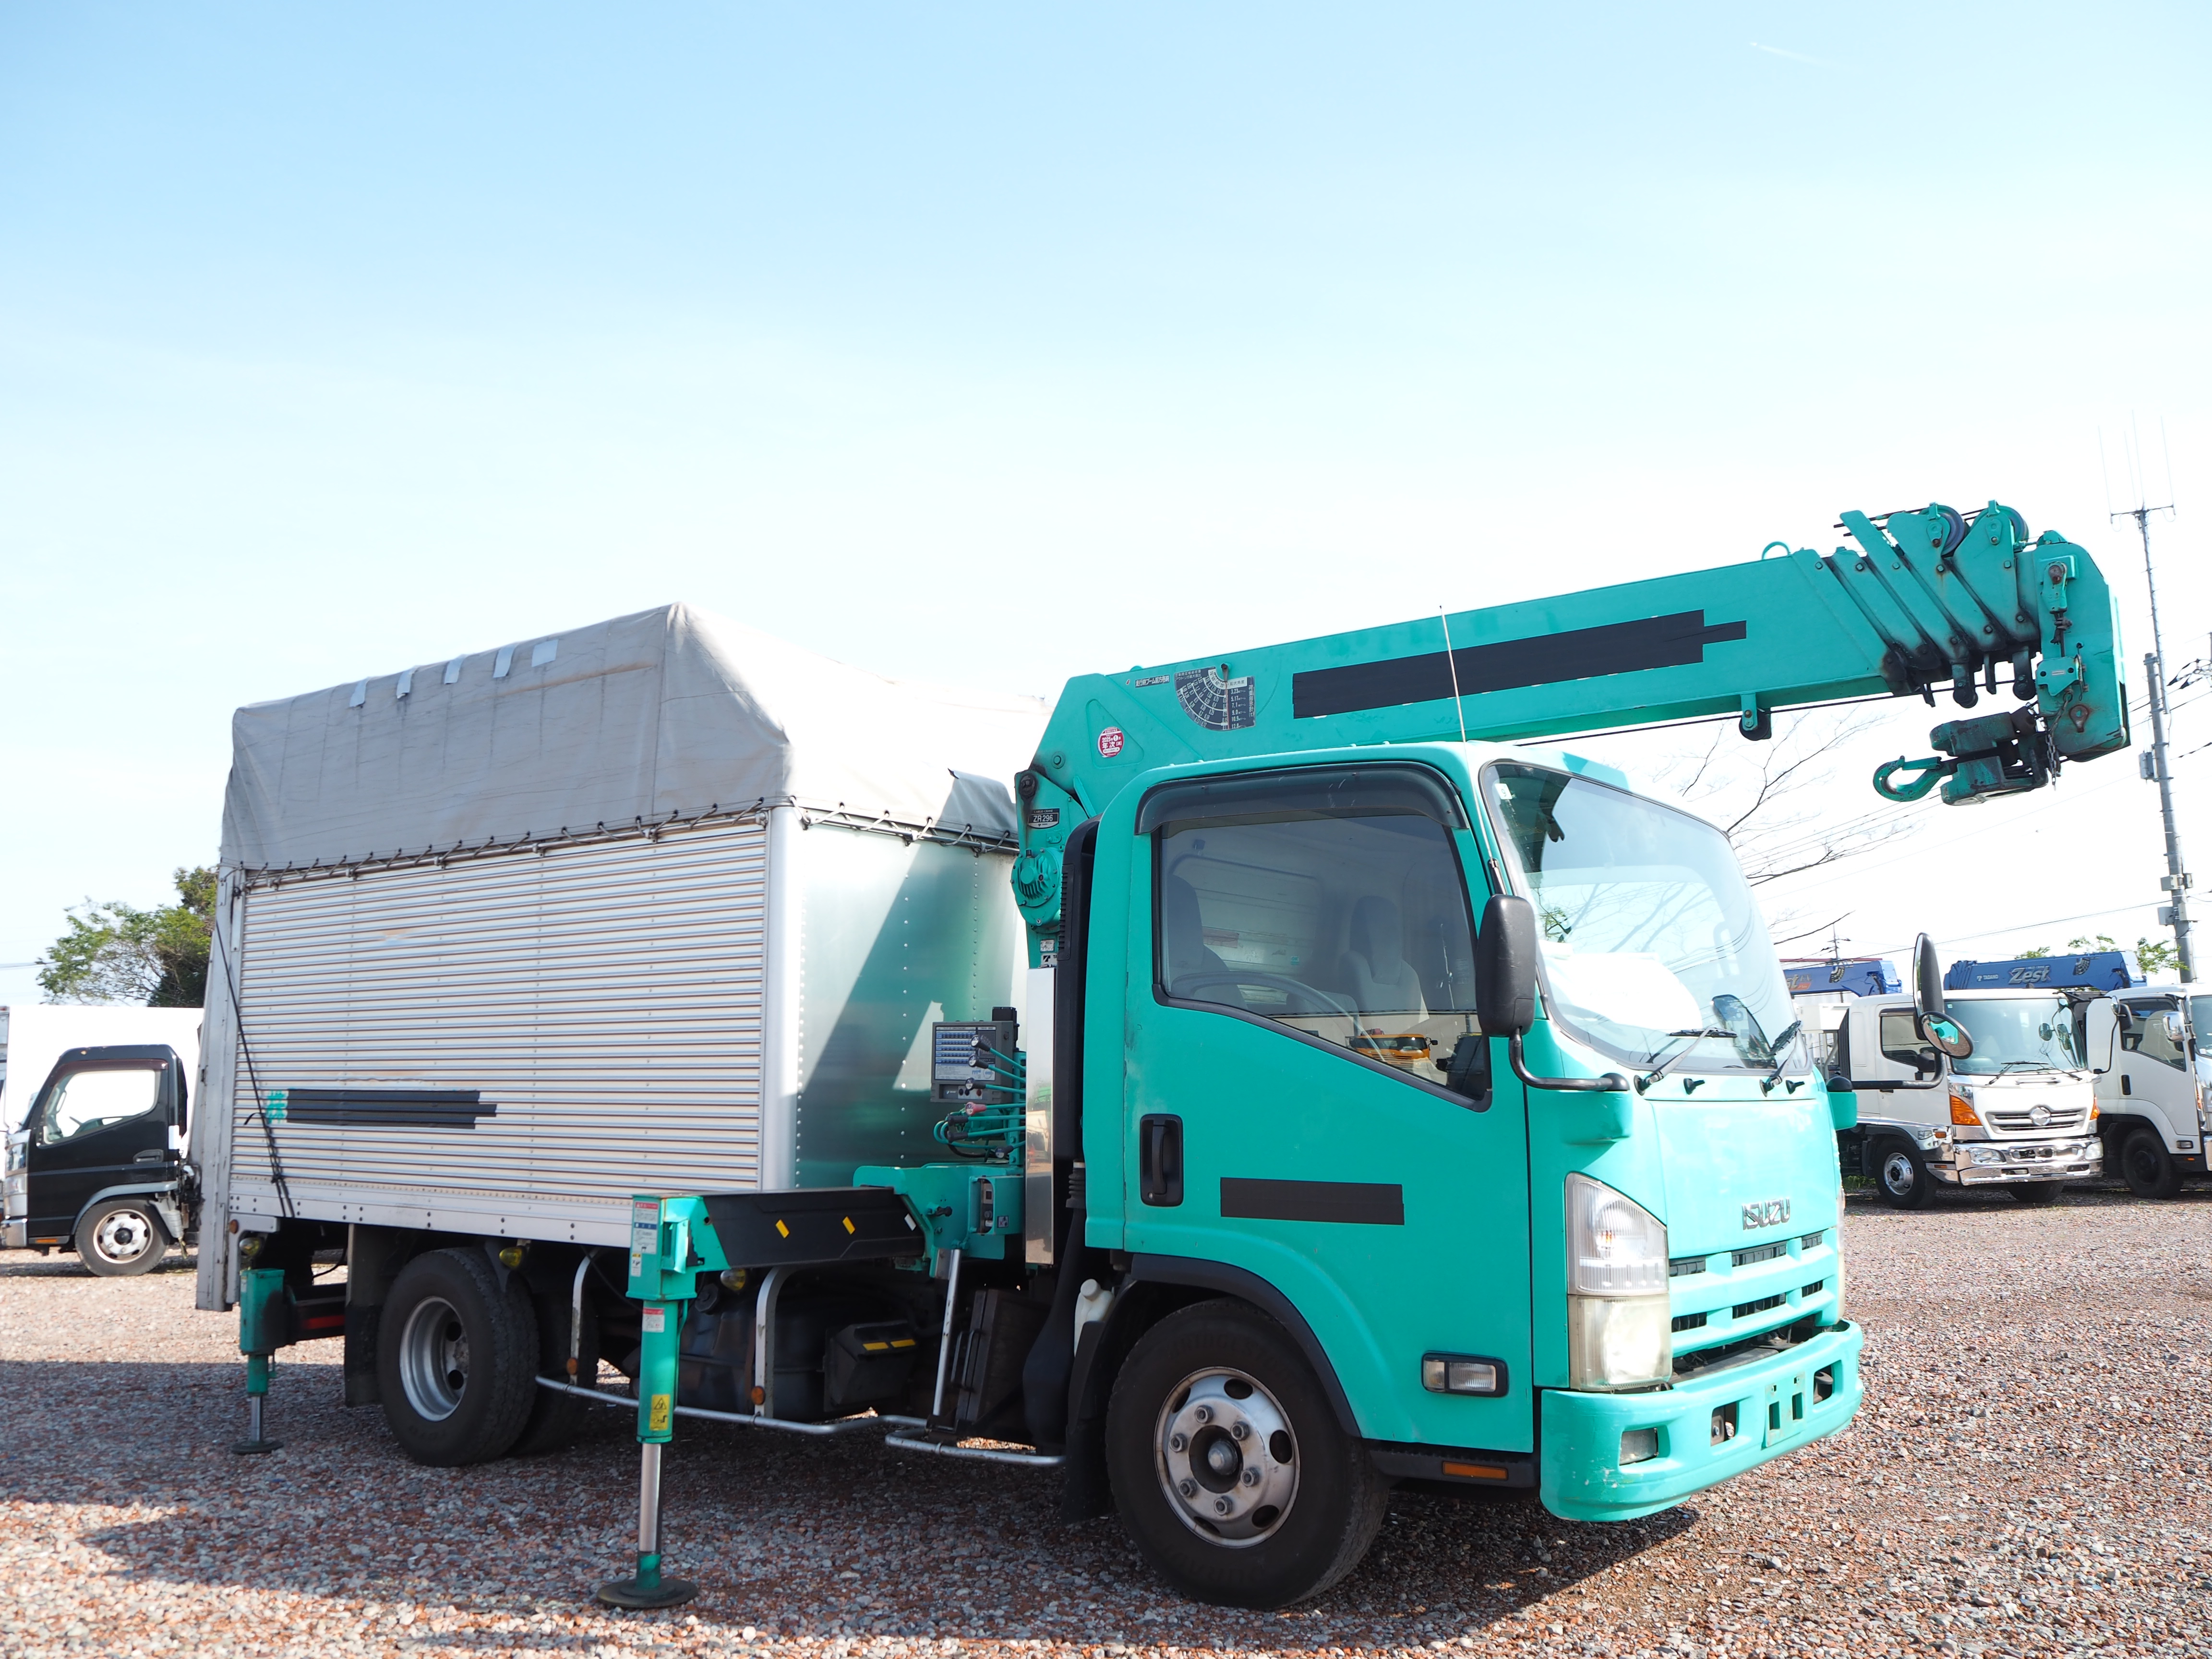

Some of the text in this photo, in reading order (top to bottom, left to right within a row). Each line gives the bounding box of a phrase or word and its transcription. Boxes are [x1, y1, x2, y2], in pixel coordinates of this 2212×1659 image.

[1033, 814, 1053, 822] ZR296
[2008, 966, 2050, 984] Zest
[1742, 1197, 1790, 1230] ISUZU
